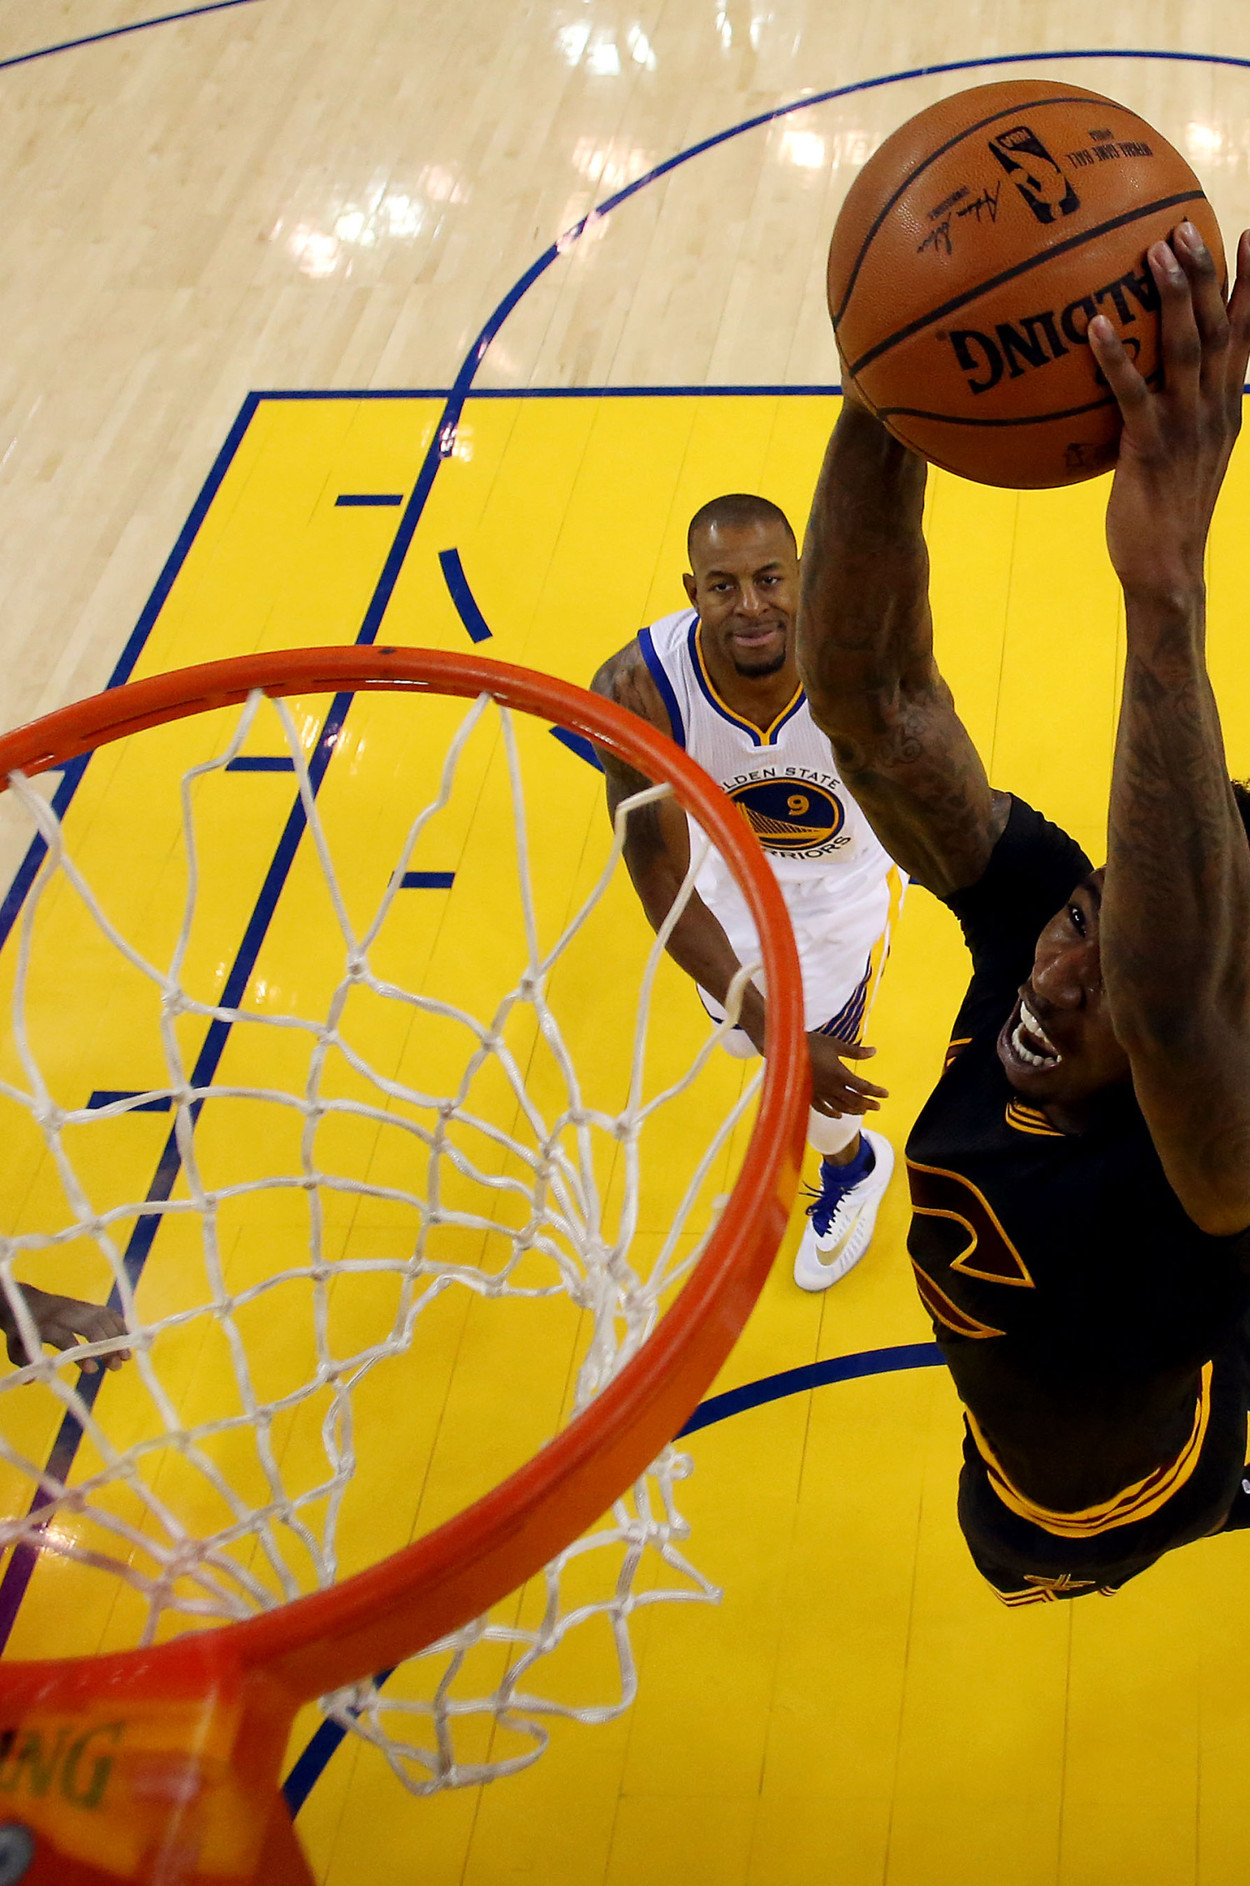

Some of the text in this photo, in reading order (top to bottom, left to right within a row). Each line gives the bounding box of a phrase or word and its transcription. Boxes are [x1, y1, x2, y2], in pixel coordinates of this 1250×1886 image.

[1065, 150, 1095, 169] BALL
[1091, 144, 1120, 161] GAME
[950, 259, 1163, 395] ALDING
[717, 767, 840, 792] LDEN STATE
[787, 794, 810, 816] 9
